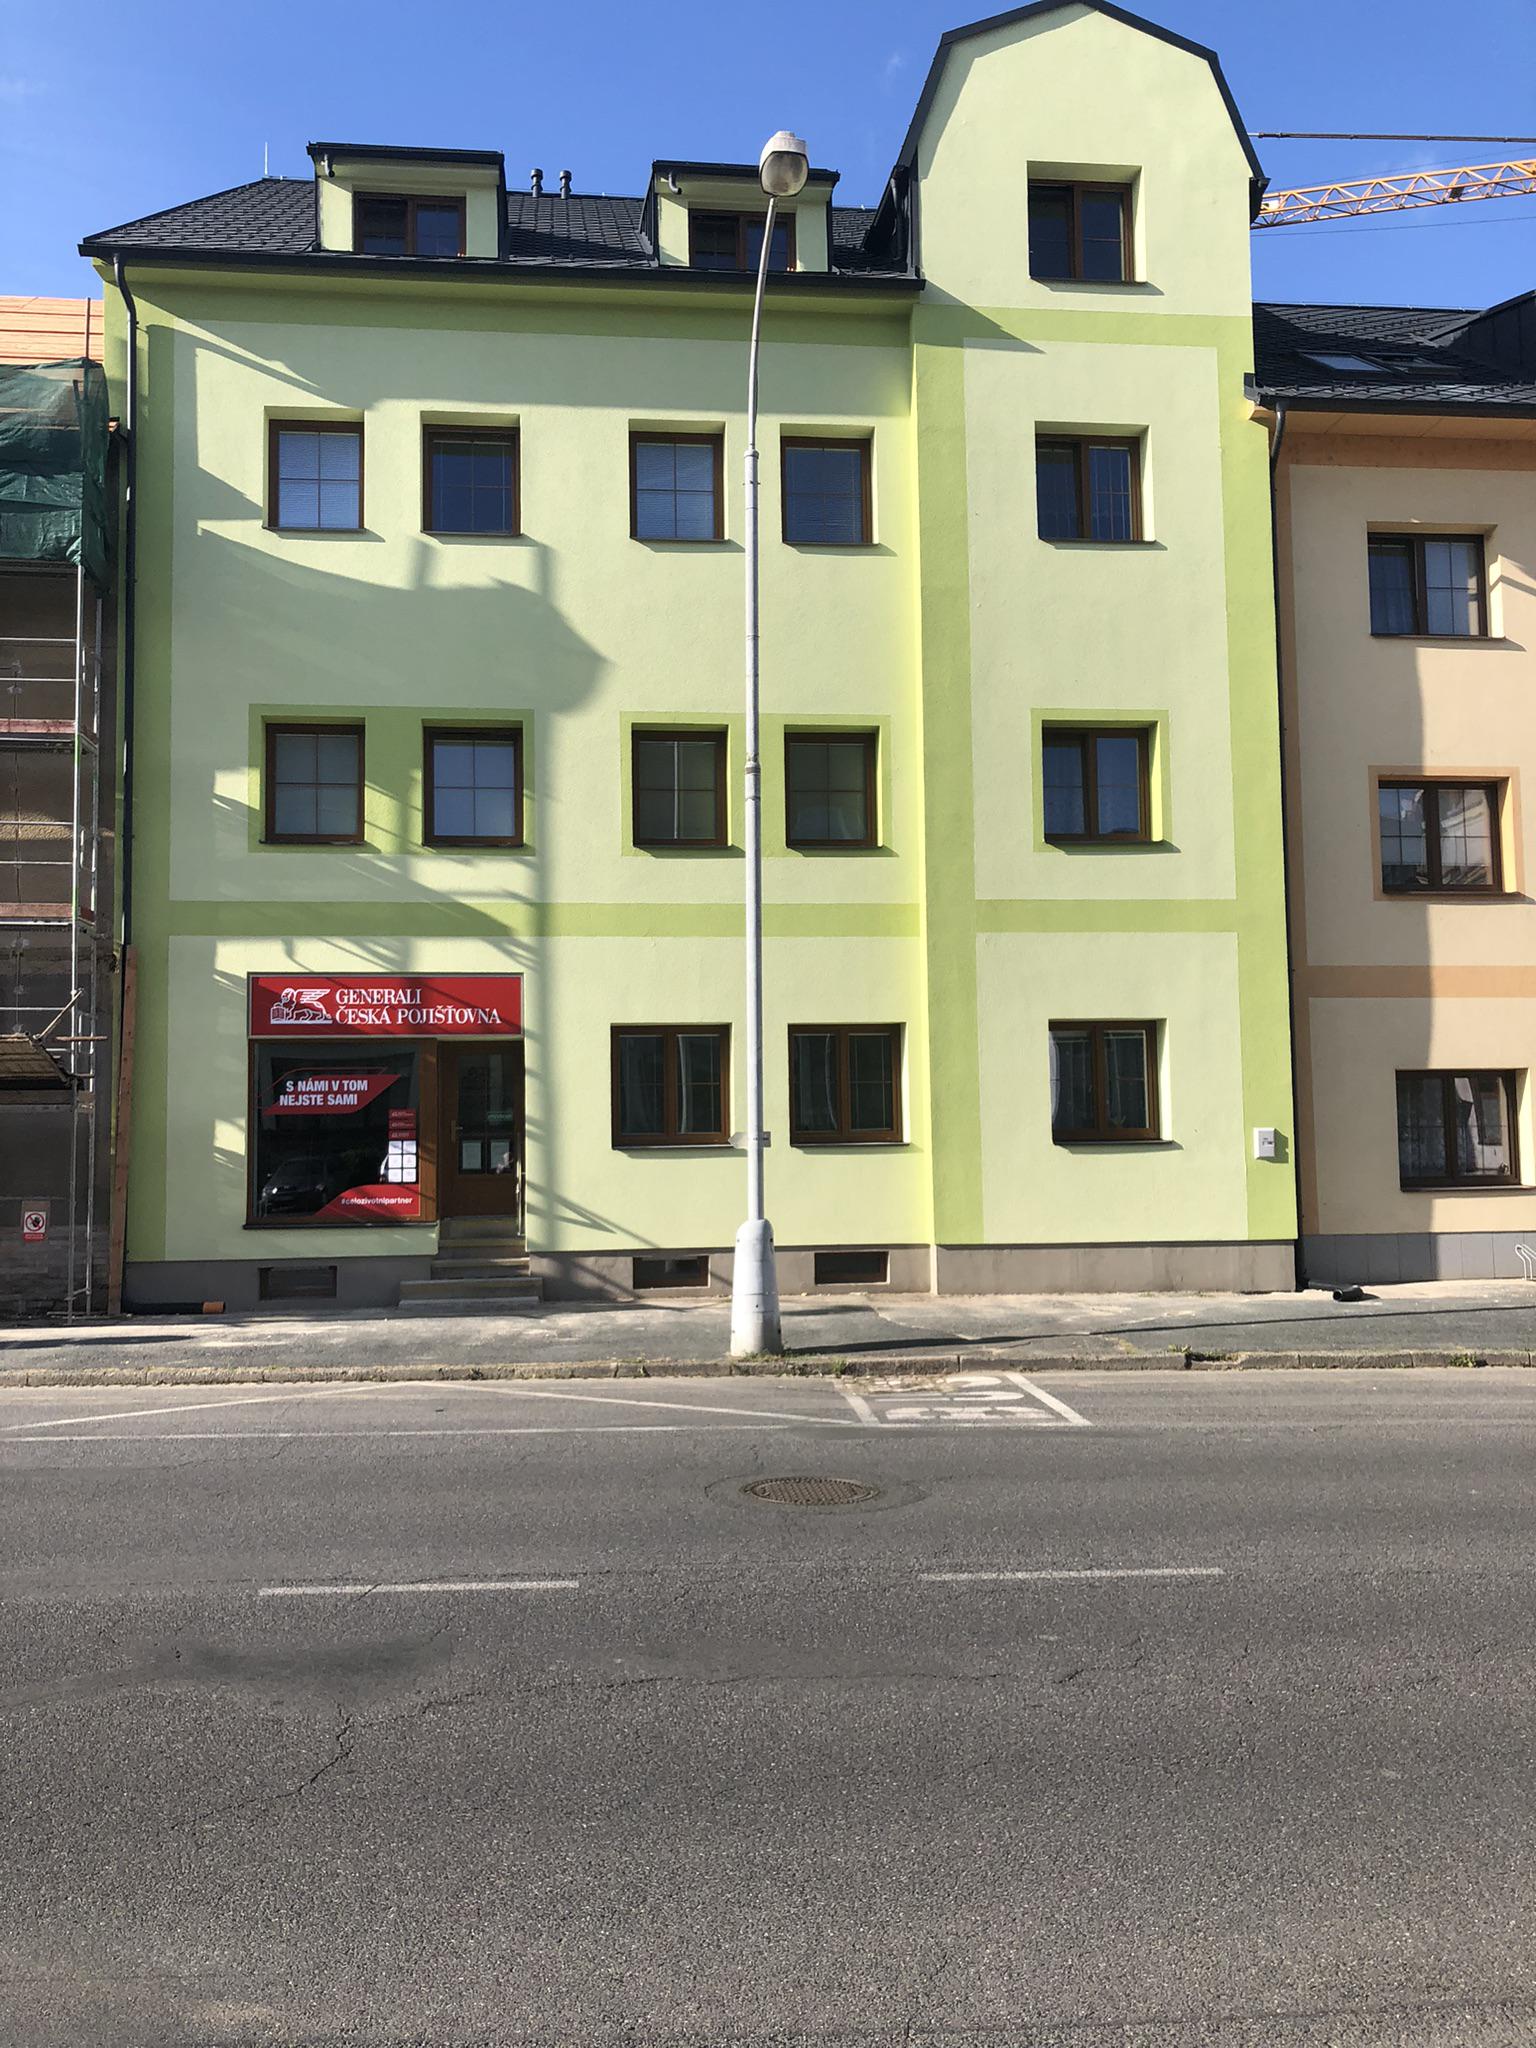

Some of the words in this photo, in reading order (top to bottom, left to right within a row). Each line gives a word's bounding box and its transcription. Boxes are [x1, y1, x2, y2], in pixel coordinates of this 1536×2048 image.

[335, 988, 422, 1005] GENERALI
[335, 1005, 392, 1025] ČESKÁ
[396, 1005, 502, 1025] POJIŠŤOVNA
[285, 1080, 294, 1092] S
[297, 1077, 329, 1092] NÁMI
[331, 1080, 341, 1091] V
[342, 1079, 368, 1091] TOM
[279, 1094, 324, 1106] NEJSTE
[327, 1094, 358, 1105] SAMI
